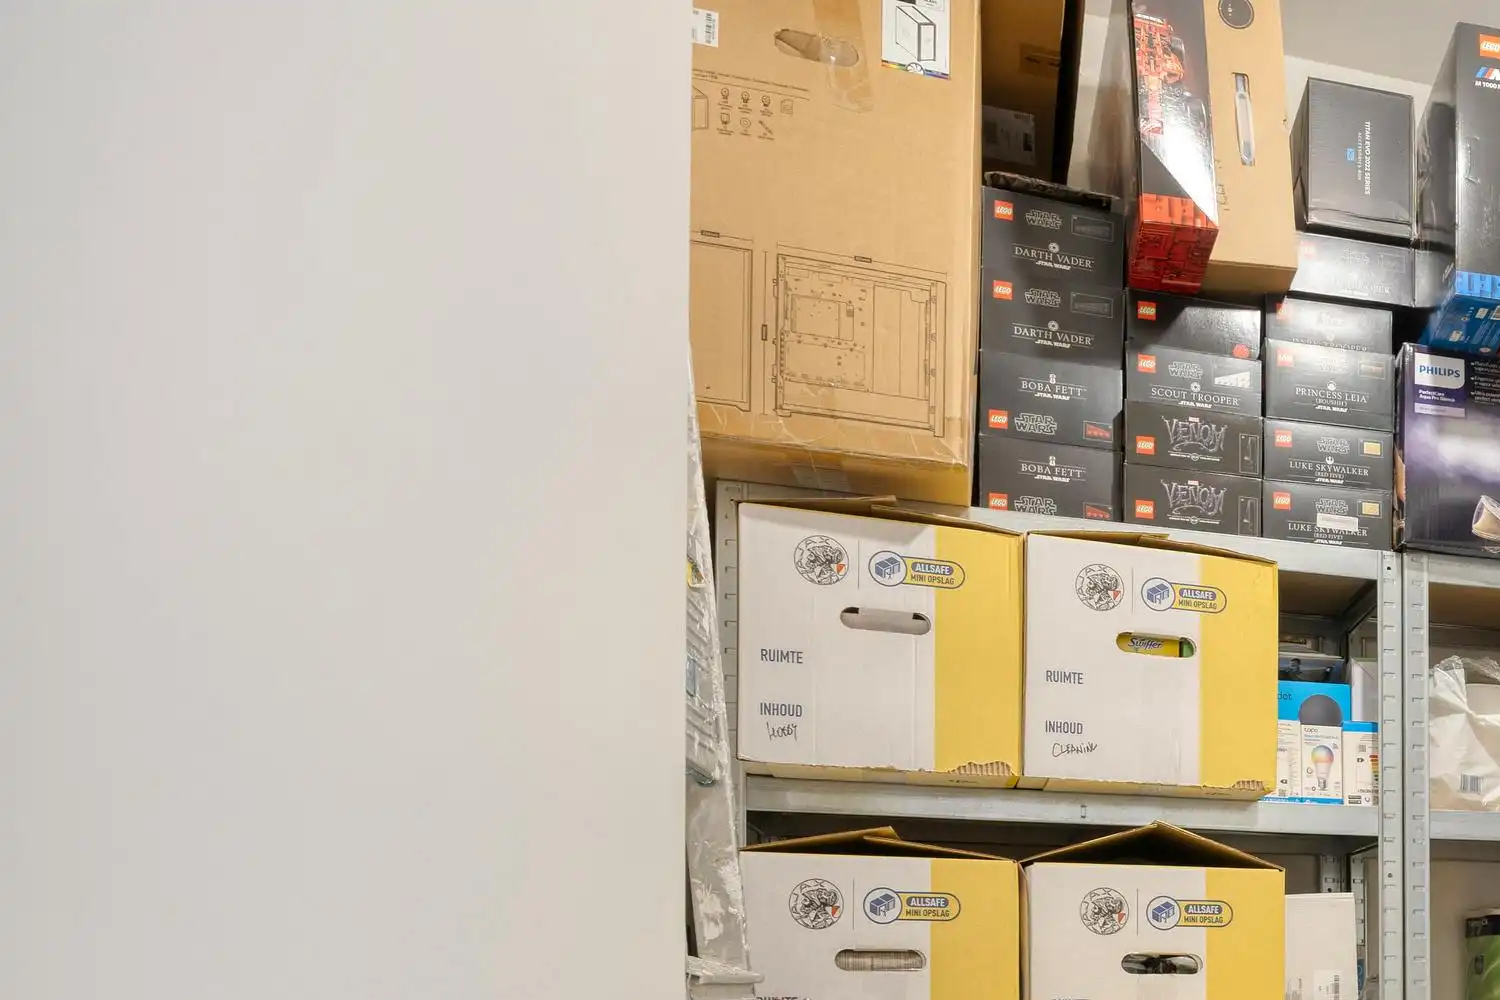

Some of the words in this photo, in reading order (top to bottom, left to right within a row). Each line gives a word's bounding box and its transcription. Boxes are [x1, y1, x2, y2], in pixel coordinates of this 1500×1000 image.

[1481, 42, 1500, 51] LEGO
[1482, 81, 1497, 89] 1000
[997, 205, 1012, 215] LEGO
[1015, 247, 1053, 260] DARTH
[1057, 254, 1092, 268] VADER
[1139, 306, 1155, 314] LEGO
[1014, 326, 1052, 340] DARTH
[1056, 333, 1091, 345] VADER
[1420, 365, 1460, 378] PHILIPS
[1022, 381, 1051, 392] BOBA
[1055, 384, 1082, 396] FETT
[1296, 387, 1342, 400] PRINCESS
[1345, 393, 1367, 403] LEIA
[1152, 388, 1187, 400] SCOUT
[1191, 392, 1239, 406] TROOPER
[1014, 413, 1055, 425] STAR
[1015, 422, 1057, 435] WARS
[1161, 416, 1227, 452] VENOM
[1021, 464, 1050, 474] BOBA
[1055, 467, 1082, 478] FETT
[1289, 461, 1313, 470] LUKE
[1316, 463, 1369, 476] SKYWALKER
[1161, 479, 1227, 515] VENOM
[1136, 505, 1153, 513] LEGO
[1288, 523, 1311, 532] LUKE
[915, 563, 951, 575] ALLSAFE
[911, 573, 926, 582] MINI
[928, 575, 954, 585] OPSLAG
[1182, 589, 1213, 600] ALLSAFE
[1179, 599, 1192, 607] MINI
[1193, 600, 1217, 610] OPSLAG
[1128, 637, 1163, 650] Swiffer
[761, 649, 803, 664] RUIMTE
[1046, 670, 1084, 685] RUIMTE
[760, 703, 803, 717] INHOUD
[1045, 720, 1083, 735] INHOUD
[910, 896, 946, 907] ALLSAFE
[906, 909, 921, 917] MINI
[923, 908, 950, 918] OPSLAG
[1188, 904, 1219, 914] ALLSAFE
[1200, 916, 1223, 924] OPSLAG
